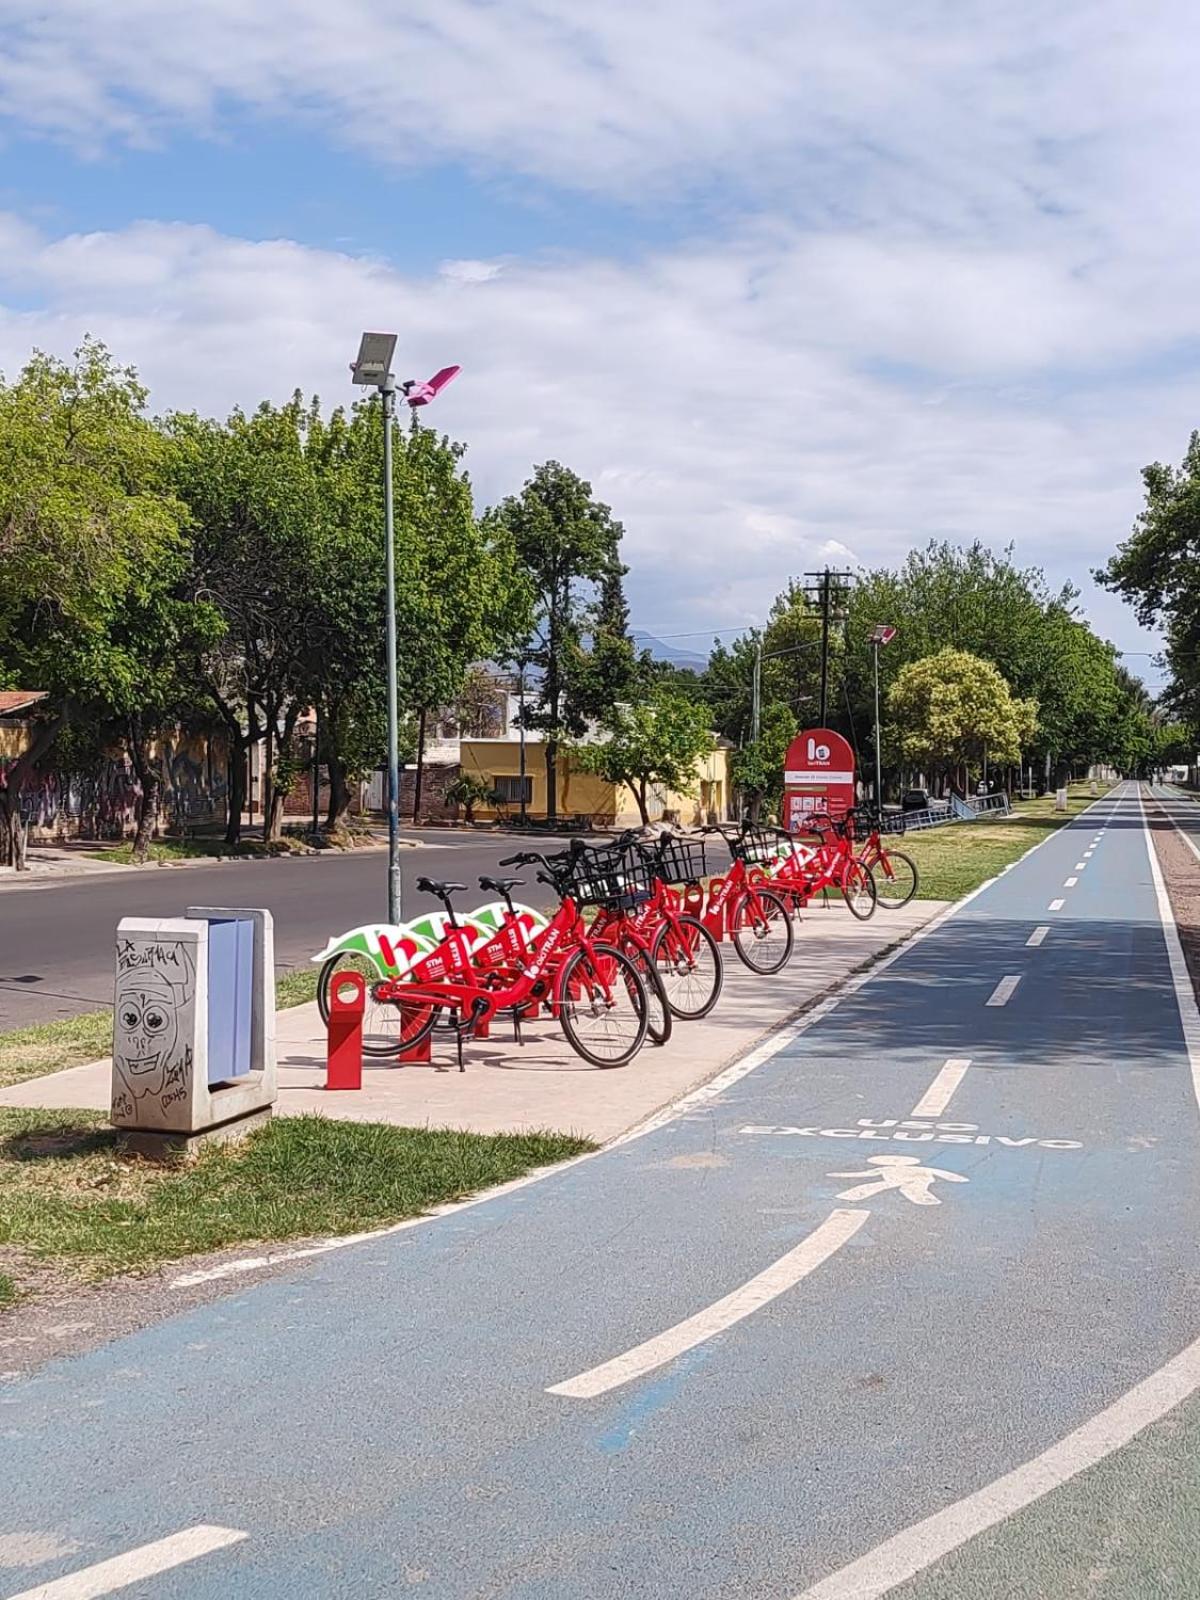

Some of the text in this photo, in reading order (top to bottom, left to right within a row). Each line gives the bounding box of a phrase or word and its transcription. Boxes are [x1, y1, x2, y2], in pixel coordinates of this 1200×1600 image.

[425, 956, 443, 969] STM
[857, 1118, 980, 1132] USO
[738, 1125, 1084, 1149] EXCLUSIVO
